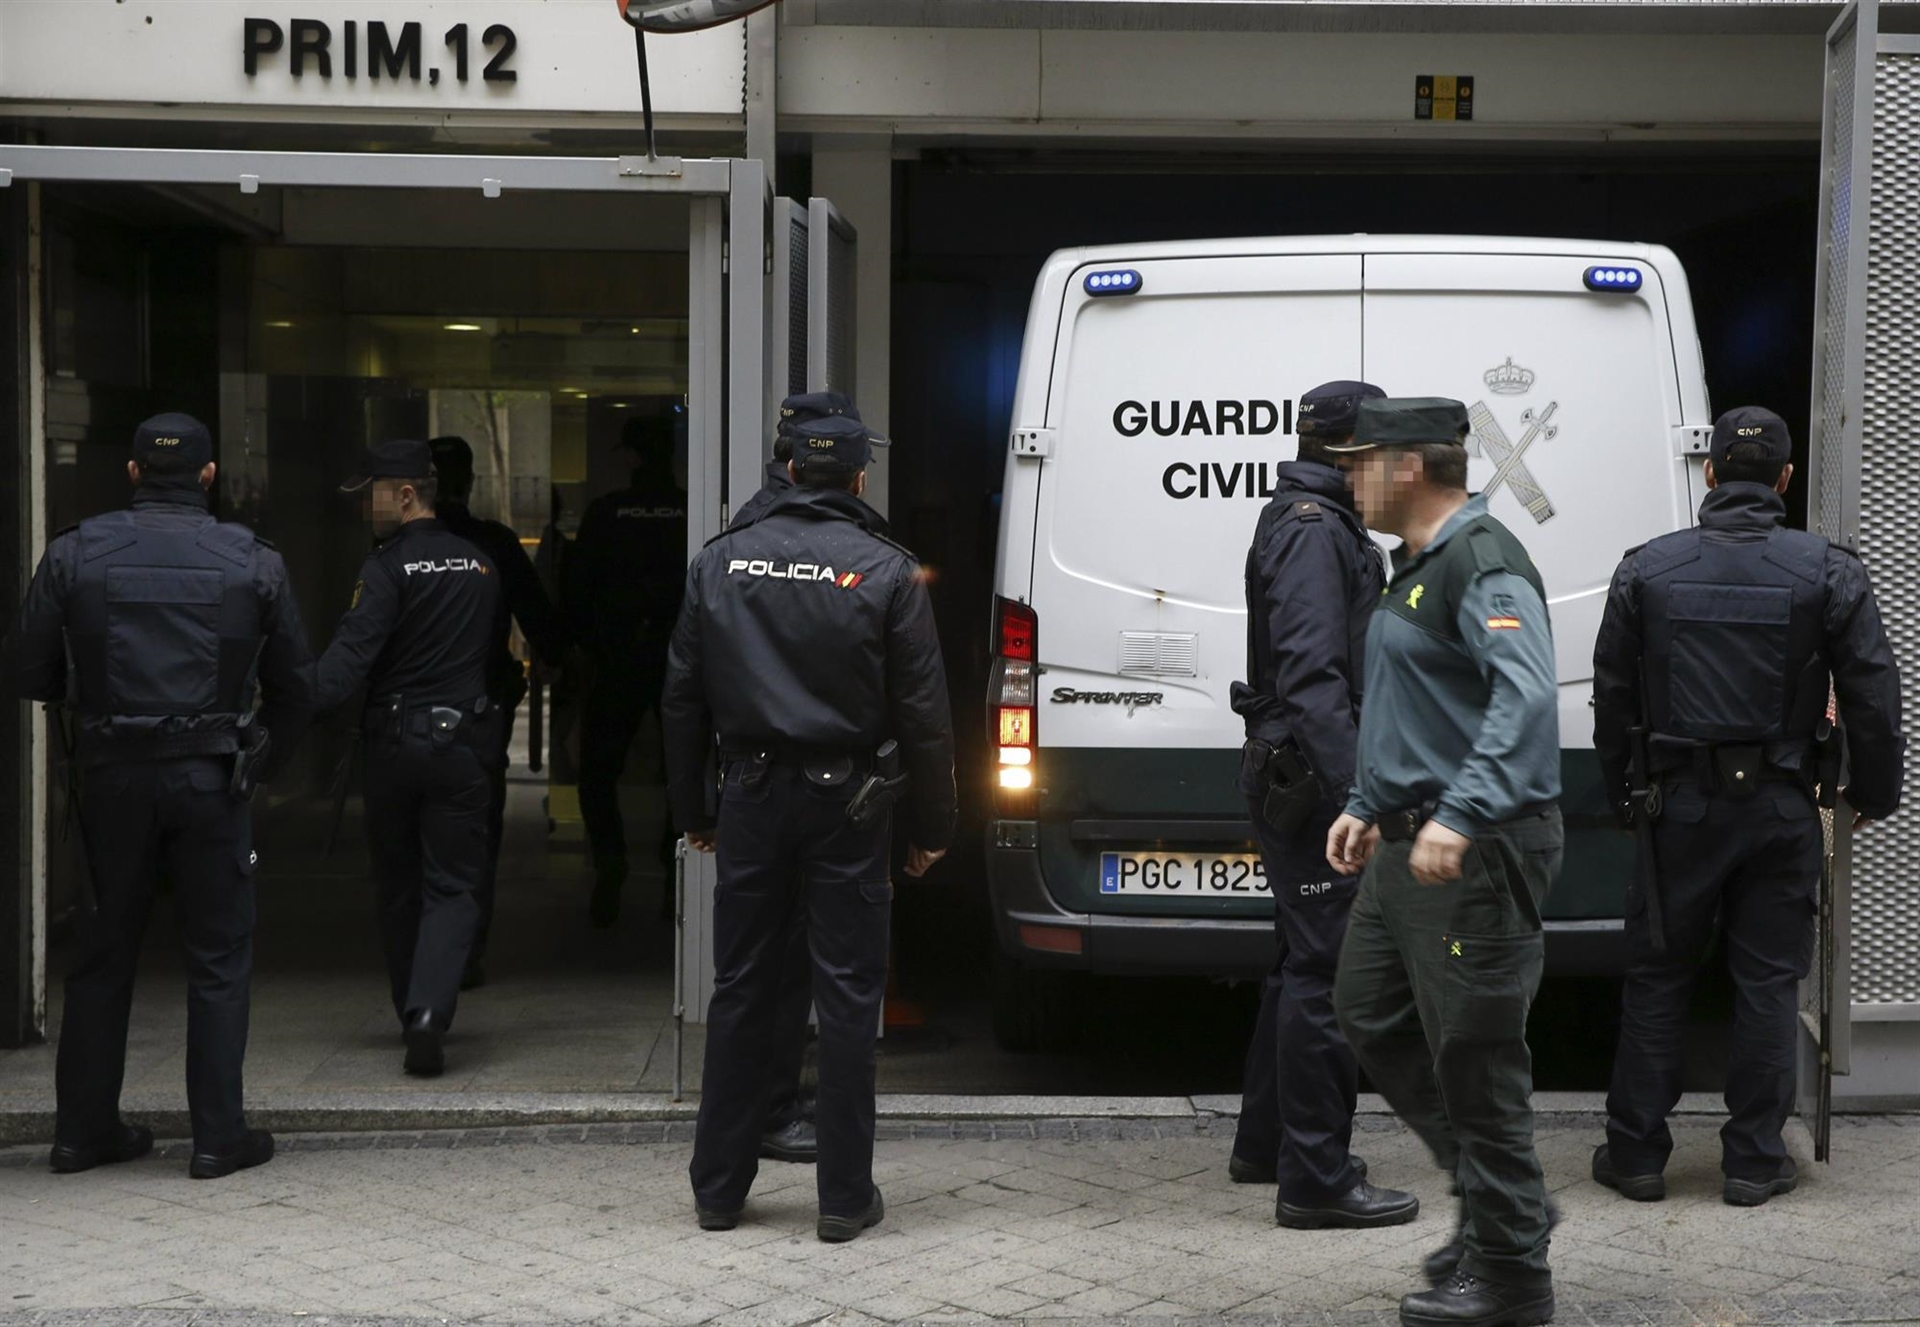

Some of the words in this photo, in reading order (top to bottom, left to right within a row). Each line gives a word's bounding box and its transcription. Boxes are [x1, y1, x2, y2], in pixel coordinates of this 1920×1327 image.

[1300, 404, 1315, 413] CNP
[1112, 399, 1300, 437] GUARDI
[1737, 427, 1762, 436] CNP
[155, 438, 180, 446] CNP
[809, 438, 834, 449] CNP
[1162, 462, 1275, 499] CIVIL
[617, 507, 684, 519] POLICIA
[403, 558, 482, 576] POLICIA
[728, 559, 836, 583] POLICIA
[1121, 858, 1182, 890] PGC
[1193, 859, 1270, 892] 1825
[1106, 877, 1114, 887] E
[1300, 882, 1332, 896] CNP
